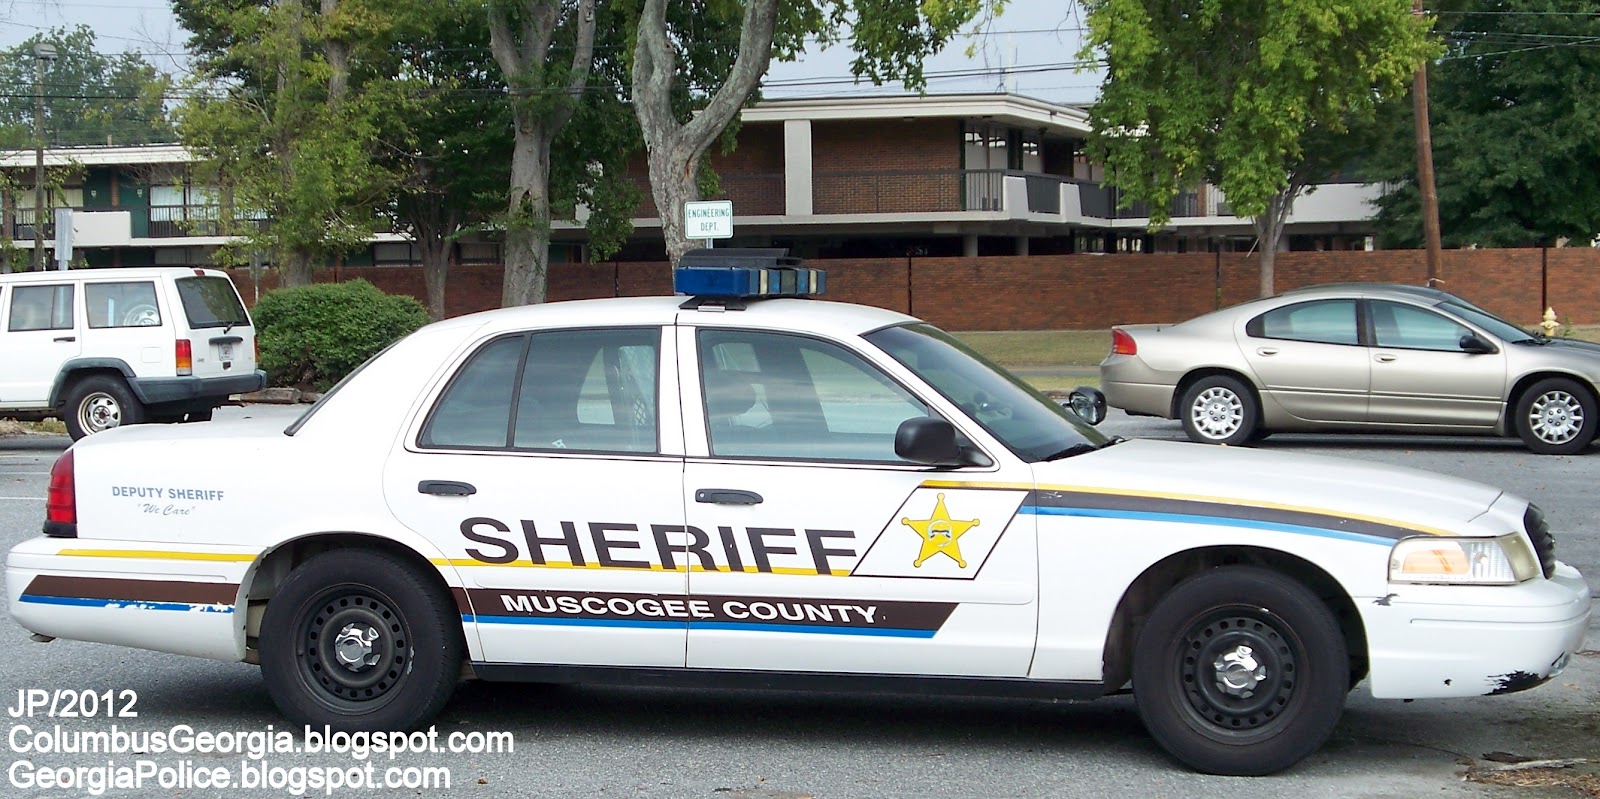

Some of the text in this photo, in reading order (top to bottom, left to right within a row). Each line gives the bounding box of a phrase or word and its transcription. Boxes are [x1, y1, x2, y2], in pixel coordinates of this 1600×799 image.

[688, 208, 730, 218] ENGINEERING
[701, 222, 719, 231] DEPT.
[112, 486, 224, 501] DEPUTY SHERIFF
[459, 516, 858, 576] SHERIFF
[500, 594, 877, 624] MUSCOGEE COUNTY
